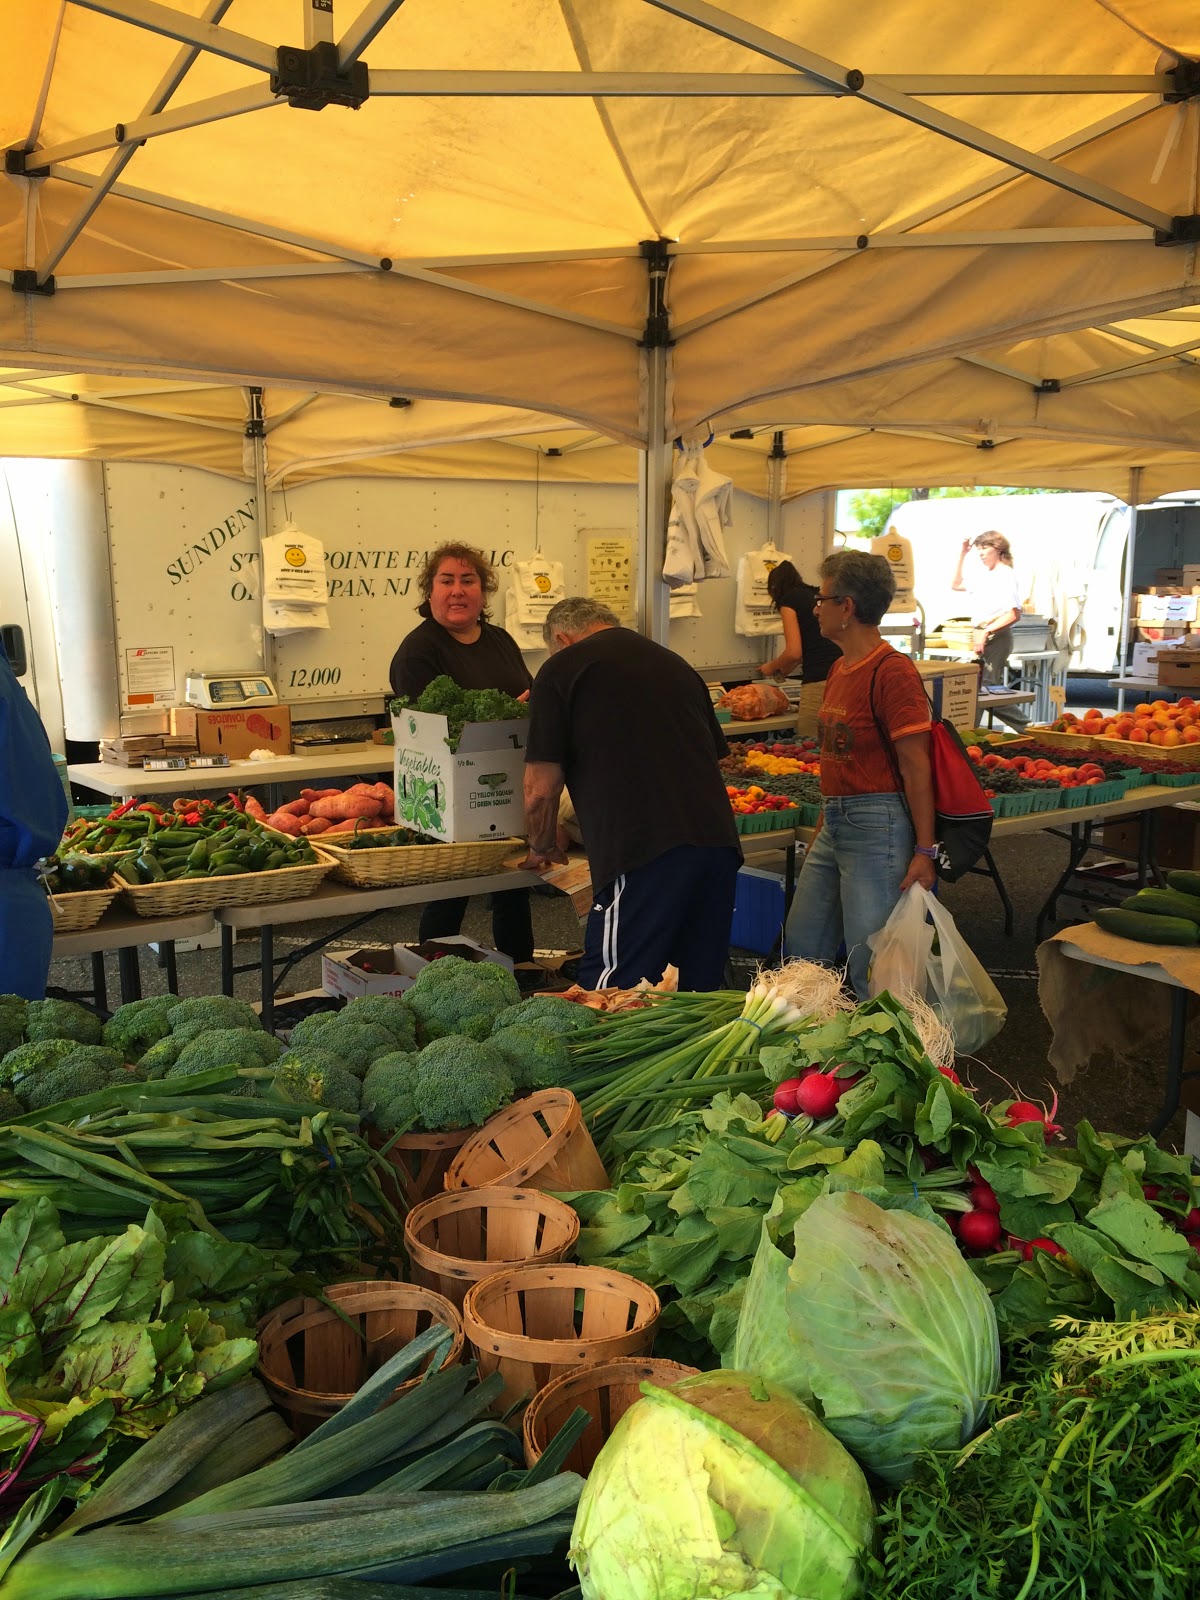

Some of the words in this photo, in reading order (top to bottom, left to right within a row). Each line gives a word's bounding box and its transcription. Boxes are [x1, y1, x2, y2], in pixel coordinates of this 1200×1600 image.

[167, 495, 257, 586] SUNDEN'
[384, 578, 412, 596] NJ
[289, 666, 341, 689] 12,000
[208, 713, 245, 725] TOMATOES
[398, 748, 441, 776] Vegetables
[477, 791, 496, 799] YELLOW
[496, 789, 514, 797] SQUASH
[477, 800, 492, 808] GREEN
[493, 798, 512, 806] SQUASH
